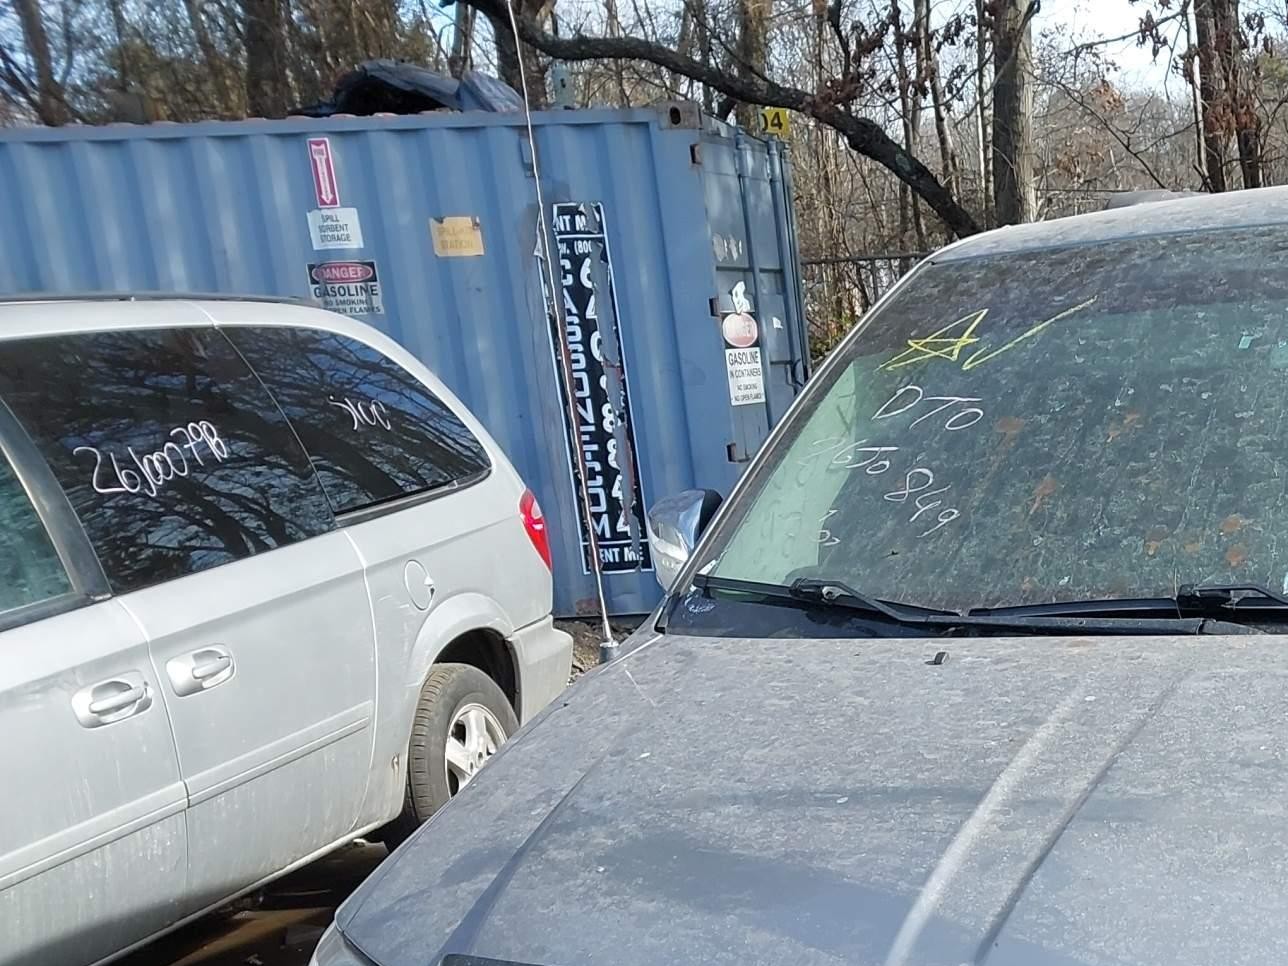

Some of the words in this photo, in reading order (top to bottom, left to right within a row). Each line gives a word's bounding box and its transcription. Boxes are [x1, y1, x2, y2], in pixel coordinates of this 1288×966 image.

[314, 284, 379, 297] GASOLINE
[335, 298, 372, 307] SMOKIN
[728, 350, 760, 366] GASOLINE
[599, 547, 620, 562] ENT
